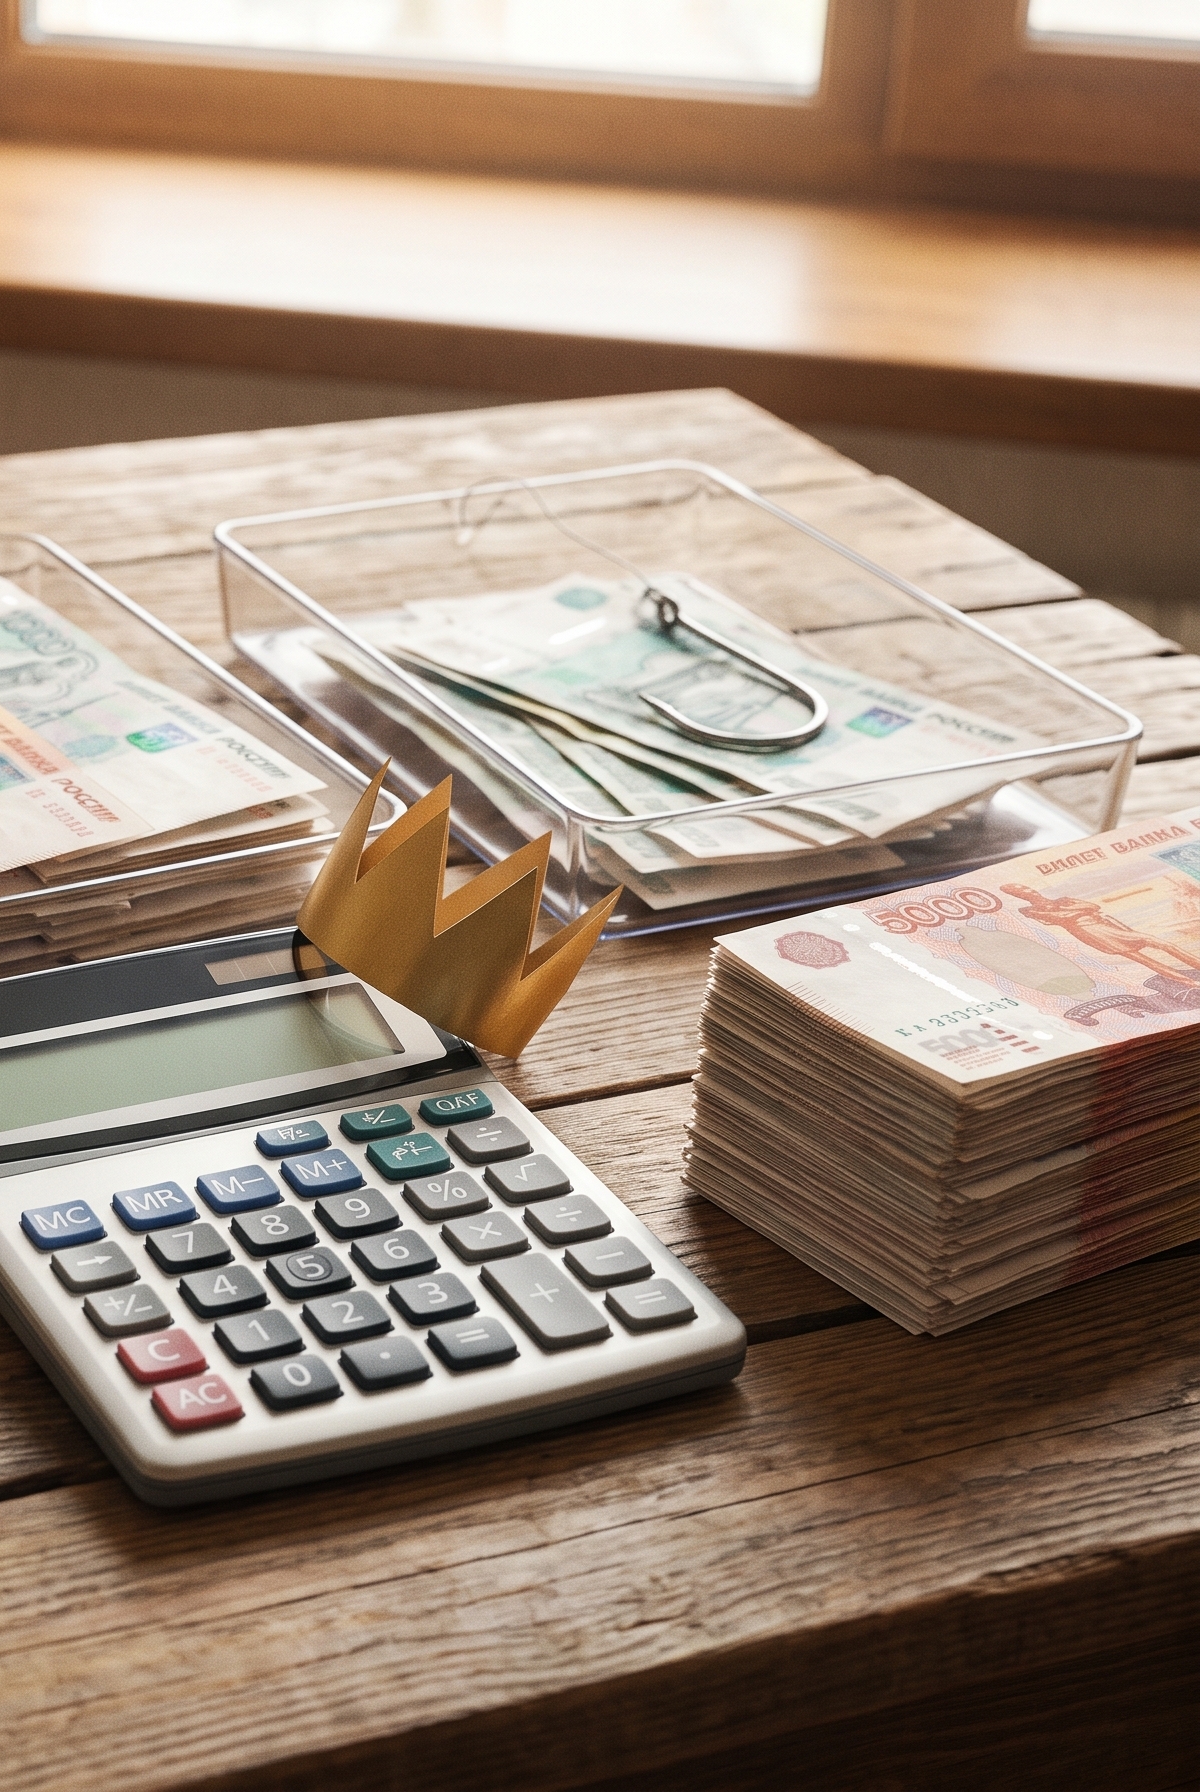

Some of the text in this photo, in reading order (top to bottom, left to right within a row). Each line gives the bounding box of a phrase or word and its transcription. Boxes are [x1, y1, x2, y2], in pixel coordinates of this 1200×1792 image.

[862, 887, 1003, 934] 5000
[298, 1158, 348, 1181] M+
[125, 1188, 183, 1216] MR
[344, 1198, 371, 1219] 9
[33, 1206, 91, 1232] MC
[260, 1214, 290, 1236] 8
[172, 1230, 194, 1254] 7
[383, 1238, 410, 1260] 6
[296, 1254, 325, 1278] 5
[213, 1274, 239, 1297] 4
[417, 1281, 449, 1304] 3
[331, 1300, 365, 1324] 2
[248, 1319, 271, 1342] 1
[147, 1338, 181, 1362] C
[282, 1362, 312, 1387] 0
[179, 1382, 228, 1409] AC
